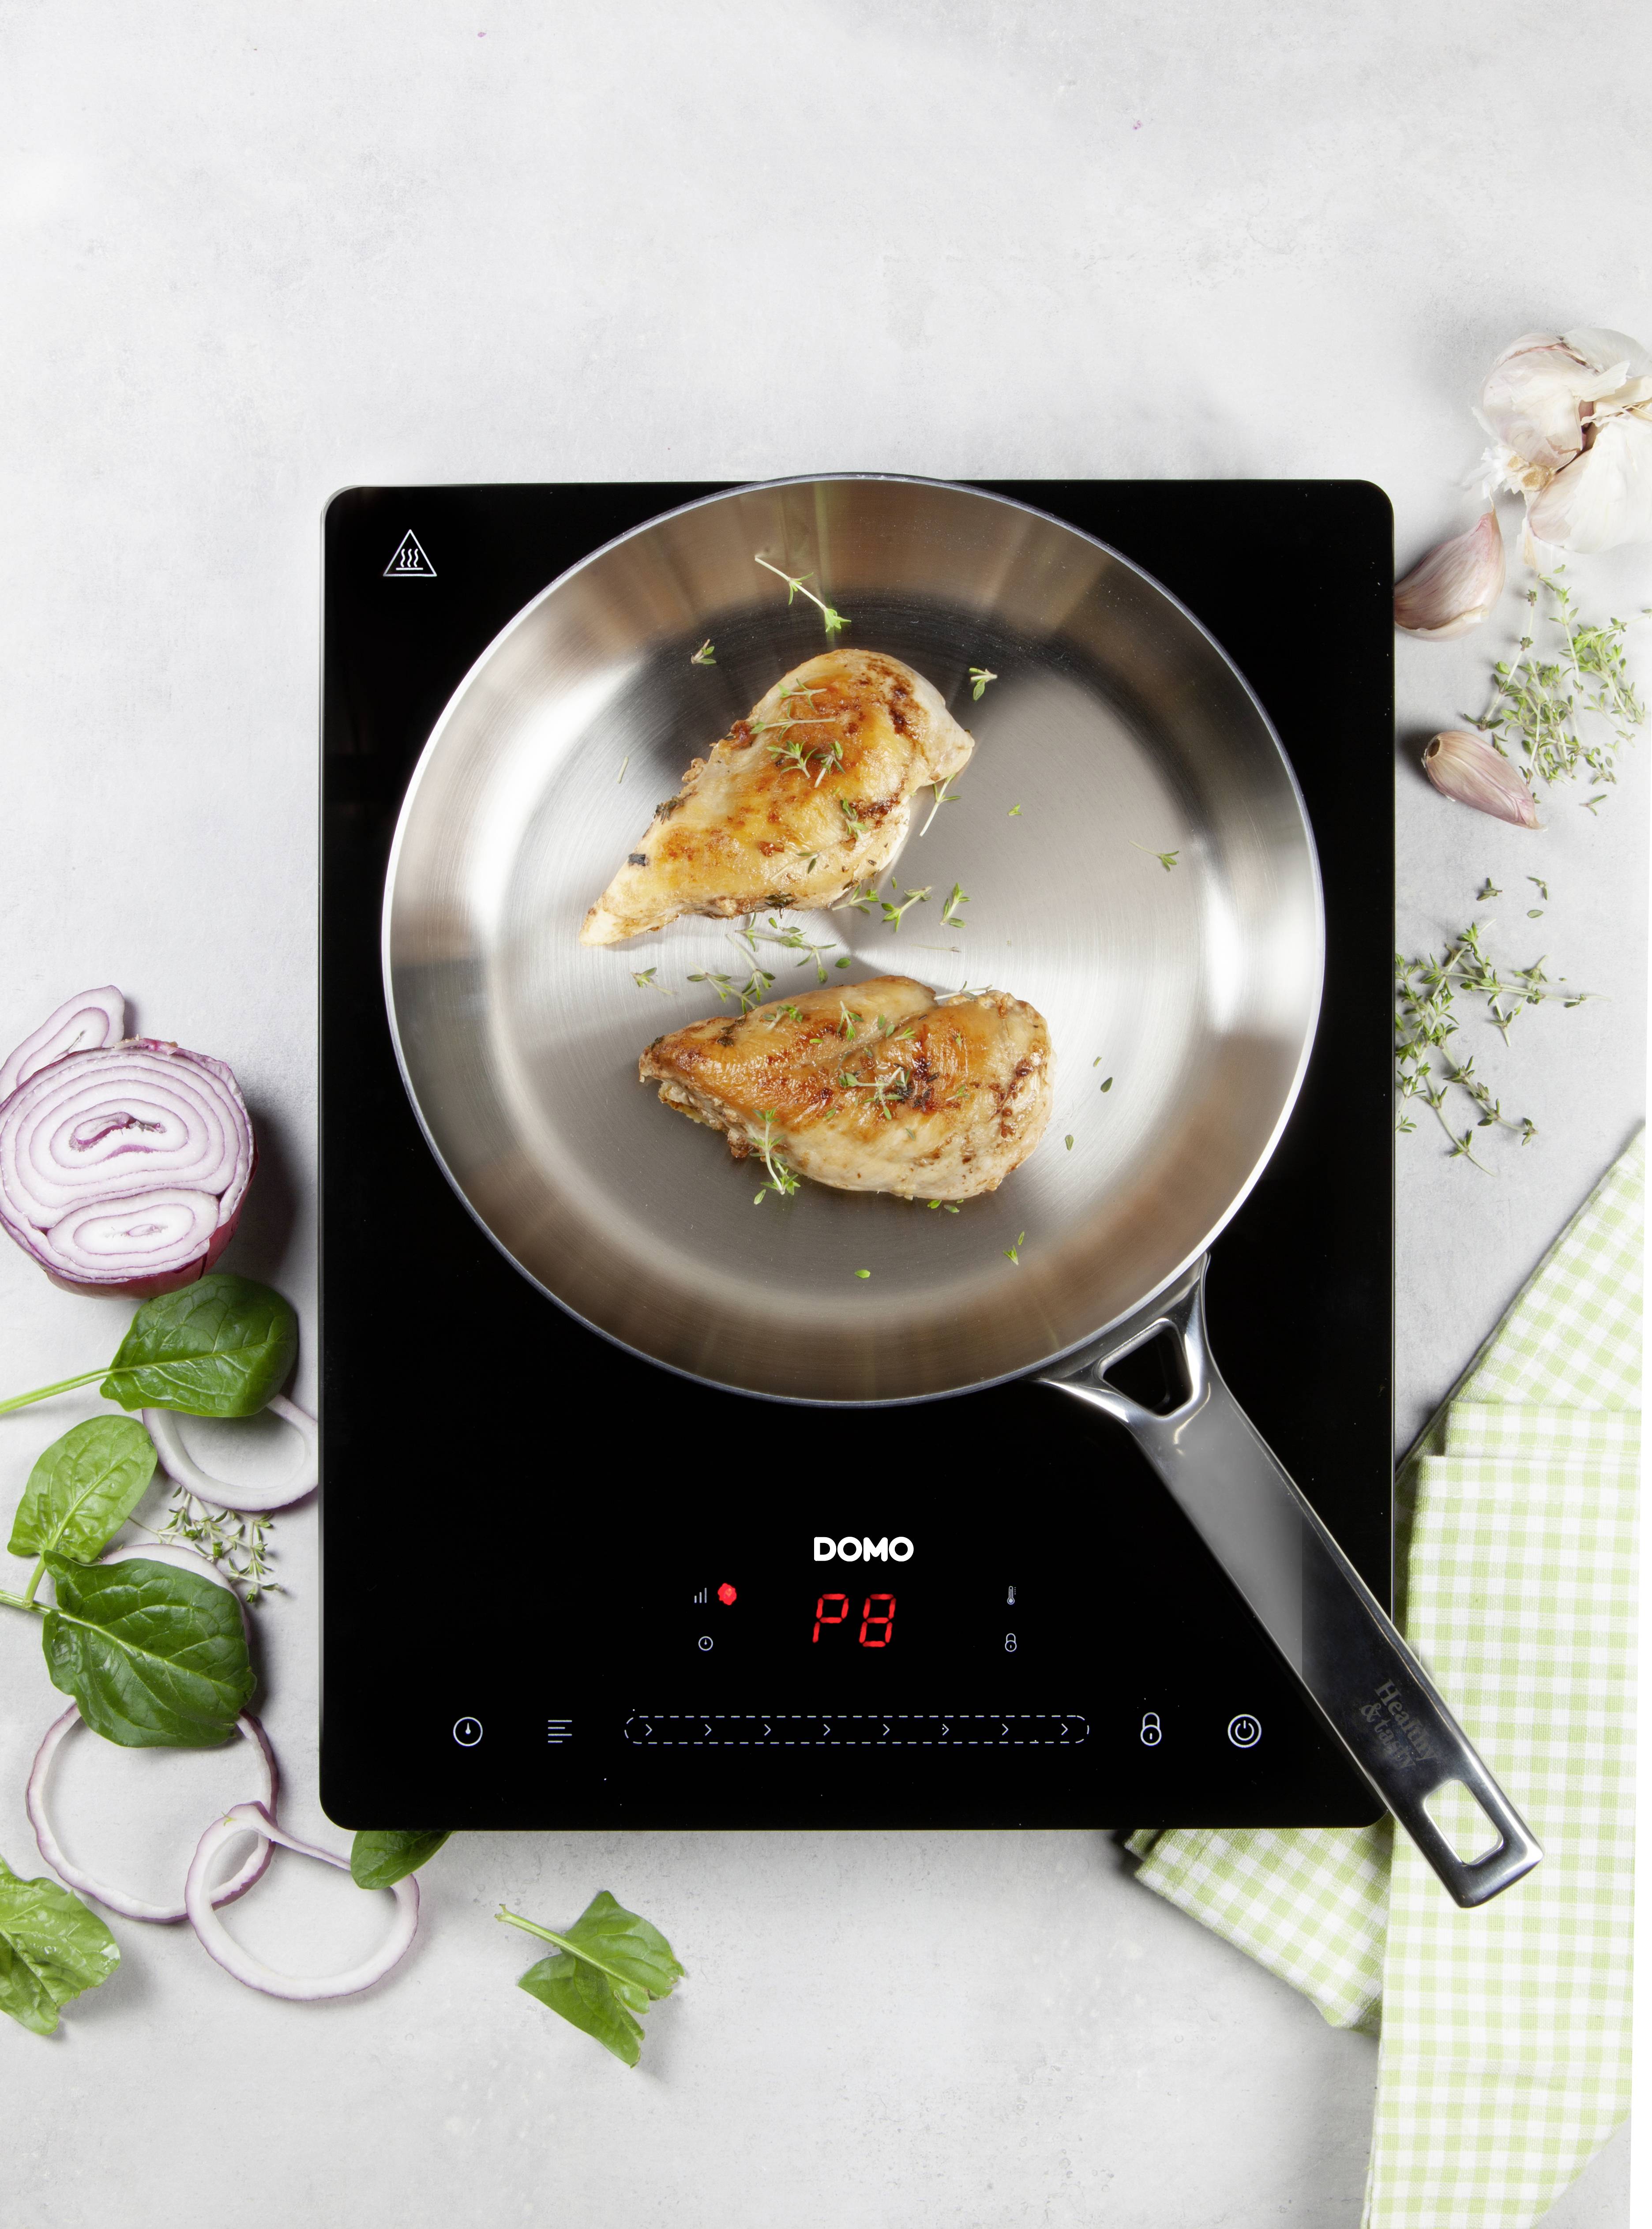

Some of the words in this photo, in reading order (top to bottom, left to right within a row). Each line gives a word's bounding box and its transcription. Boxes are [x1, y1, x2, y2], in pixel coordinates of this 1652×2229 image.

[814, 1536, 914, 1562] DOMO
[812, 1593, 896, 1647] P8
[1374, 1679, 1437, 1761] Healthy
